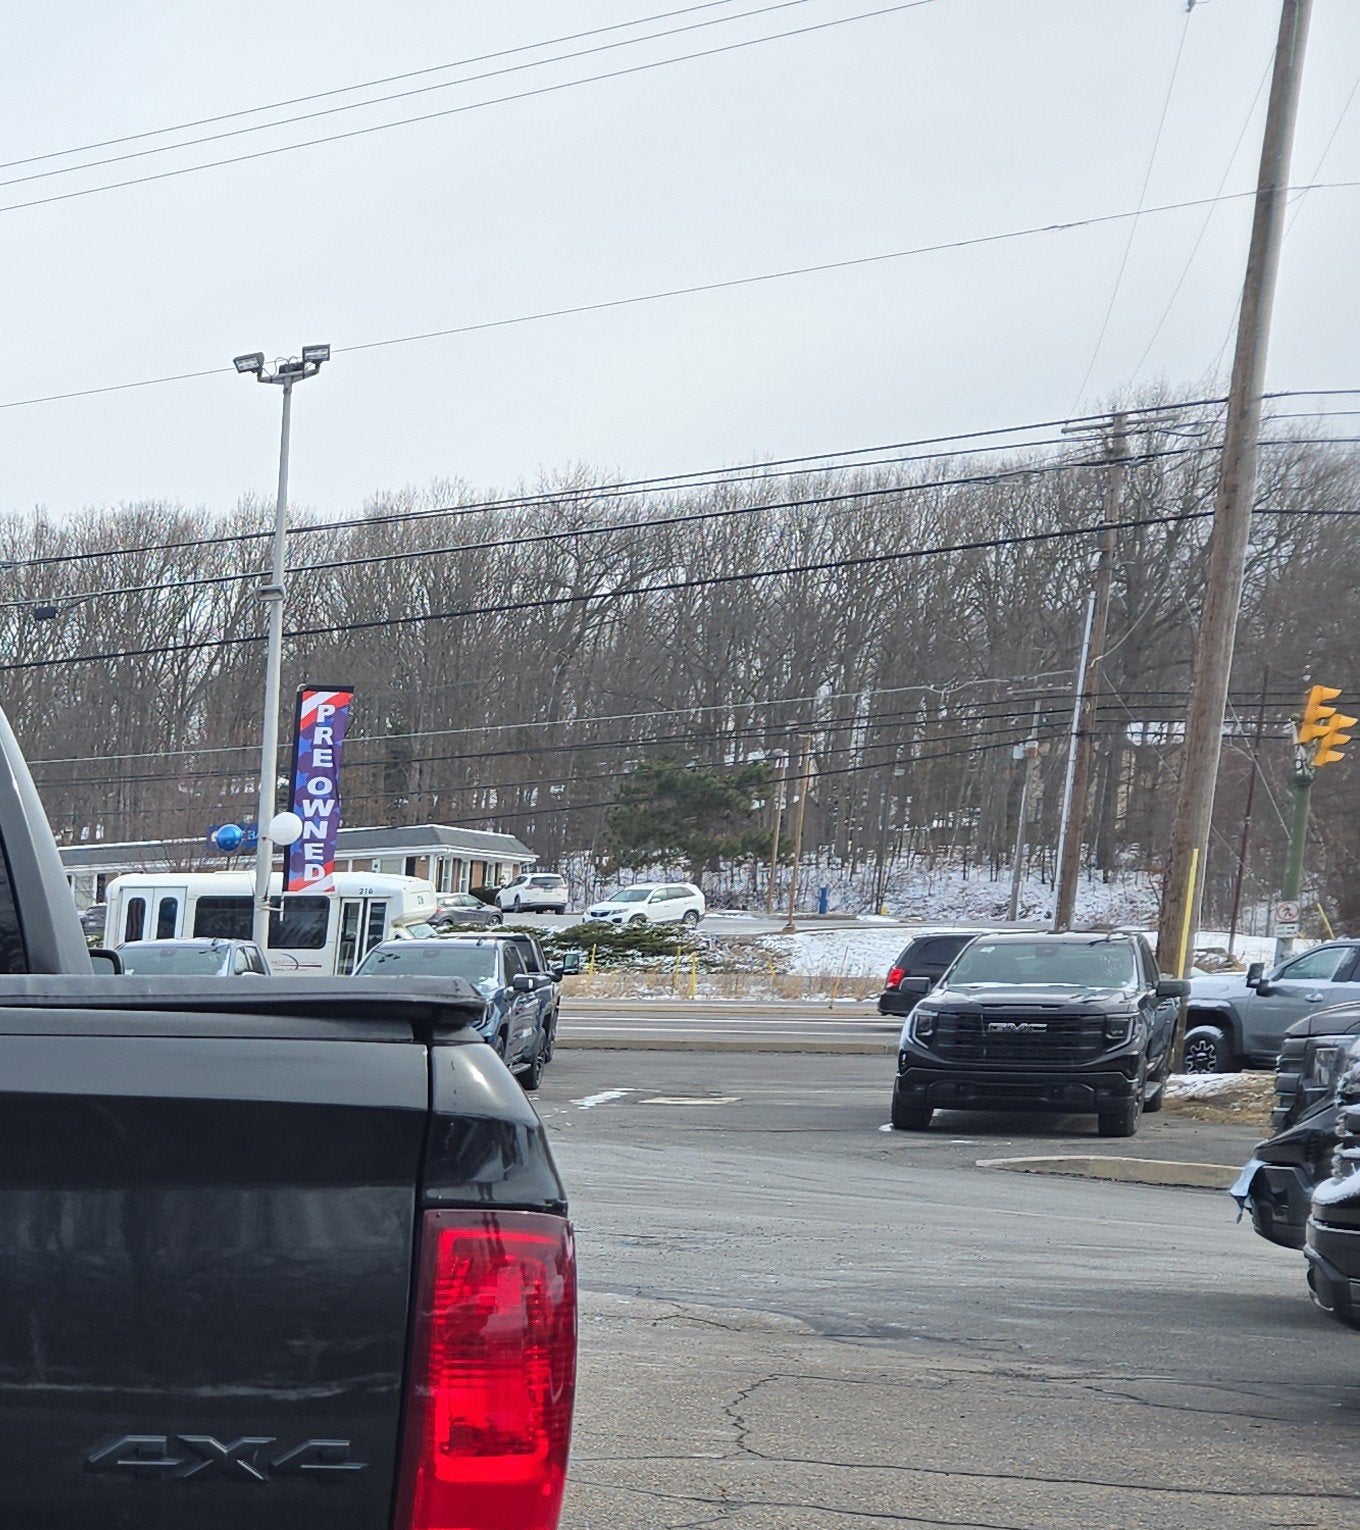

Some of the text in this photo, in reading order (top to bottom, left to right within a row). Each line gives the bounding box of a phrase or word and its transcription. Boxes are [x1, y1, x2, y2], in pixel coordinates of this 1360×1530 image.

[302, 704, 335, 881] PRE OWNED
[359, 887, 374, 895] 216
[987, 1022, 1048, 1033] GMC
